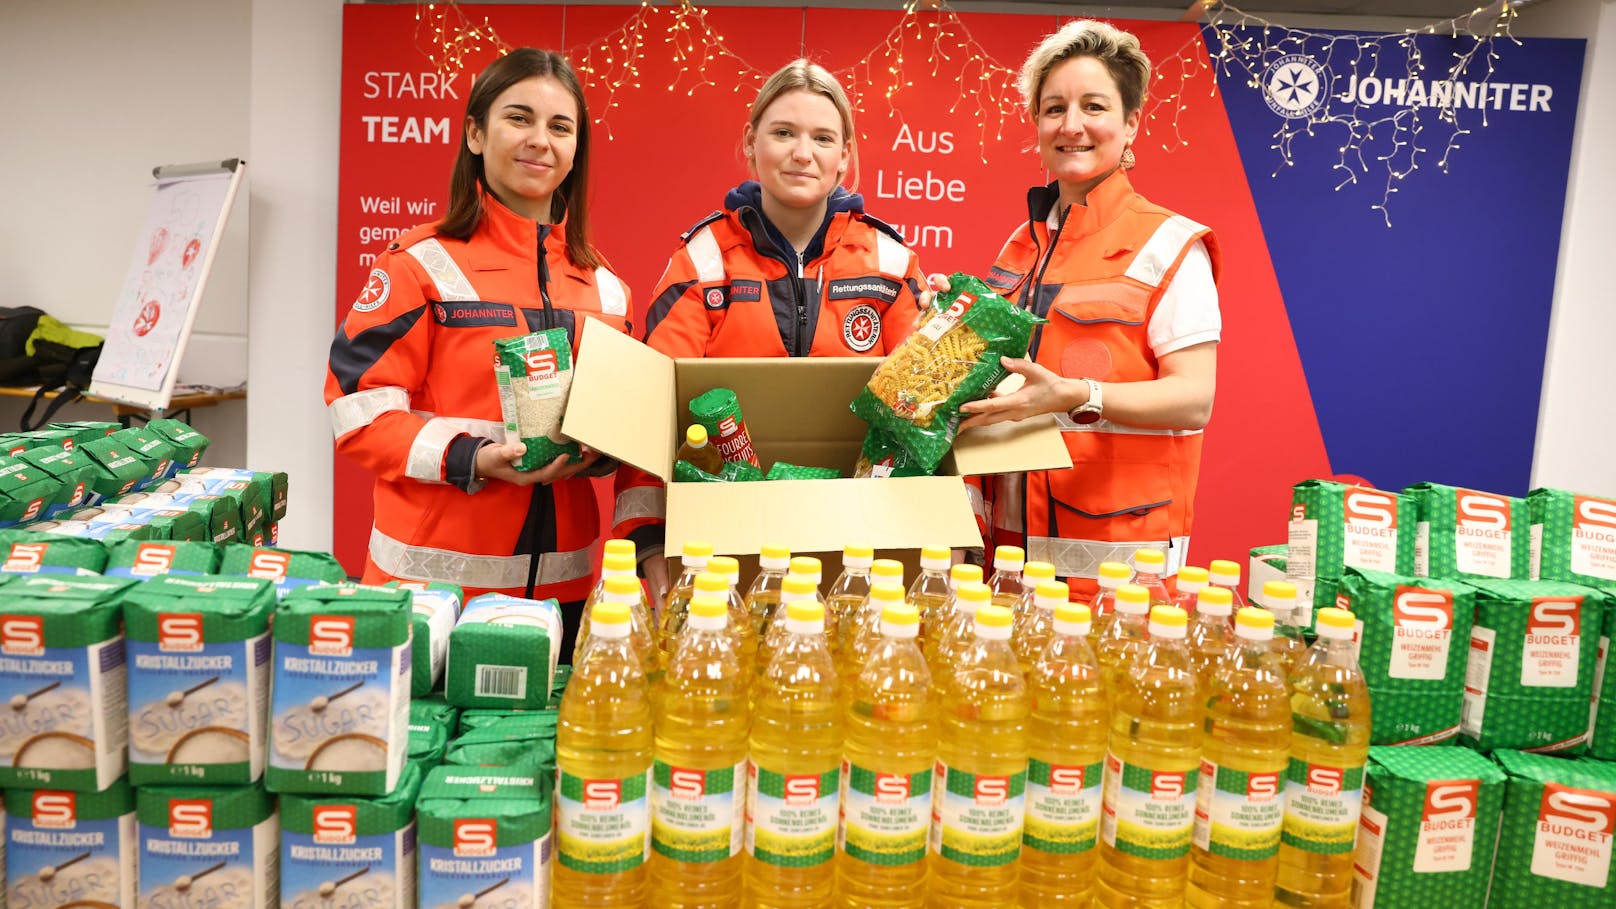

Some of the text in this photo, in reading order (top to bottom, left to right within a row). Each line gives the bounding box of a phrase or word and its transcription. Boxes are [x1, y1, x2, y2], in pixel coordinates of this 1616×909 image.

[363, 71, 459, 101] STARK
[1340, 76, 1553, 112] JOHANNITER
[362, 115, 450, 144] TEAM
[892, 124, 954, 154] Aus
[877, 169, 966, 202] Liebe
[360, 196, 437, 216] Weil wir
[450, 308, 514, 320] JOHANNITER
[528, 372, 558, 382] BUDGET
[1293, 506, 1305, 520] S
[1347, 493, 1392, 529] S
[1460, 495, 1507, 531] S
[1347, 524, 1394, 538] BUDGET
[1458, 526, 1509, 540] BUDGET
[1575, 529, 1616, 543] BUDG
[136, 548, 171, 571] S
[252, 553, 286, 577] S
[1397, 592, 1448, 630] S
[1533, 602, 1576, 636] S
[4, 621, 40, 648] S
[163, 618, 200, 645] S
[313, 621, 351, 647] S
[1397, 627, 1449, 640] BUDGET
[1527, 634, 1576, 645] BUDGET
[1400, 644, 1442, 653] WEIZENMEHL
[1408, 652, 1433, 661] GRIFFIG
[136, 655, 233, 671] KRISTALLZUCKER
[284, 656, 378, 675] KRISTALLZUCKER
[140, 697, 233, 739] SUGAR
[283, 704, 374, 743] SUGAR
[672, 771, 703, 796] S
[787, 779, 817, 802] S
[877, 777, 908, 800] S
[976, 779, 1006, 802] S
[1052, 769, 1082, 792] S
[1154, 775, 1183, 798] S
[1249, 775, 1276, 798] S
[1309, 768, 1340, 791] S
[586, 783, 618, 806] S
[1430, 785, 1473, 822] S
[36, 795, 72, 820] S
[172, 804, 208, 831] S
[1547, 791, 1611, 832] S
[317, 811, 352, 837] S
[1423, 818, 1472, 832] BUDGET
[1541, 823, 1609, 844] BUDGET
[12, 829, 104, 846] KRISTALLZUCKER
[146, 838, 239, 855] KRISTALLZUCKER
[457, 824, 493, 850] S
[290, 845, 383, 860] KRISTALLZUCKER
[1545, 840, 1601, 858] WEIZENMEHL
[1555, 851, 1588, 865] GRIFFIG
[430, 857, 522, 872] KRISTALLZUCKER
